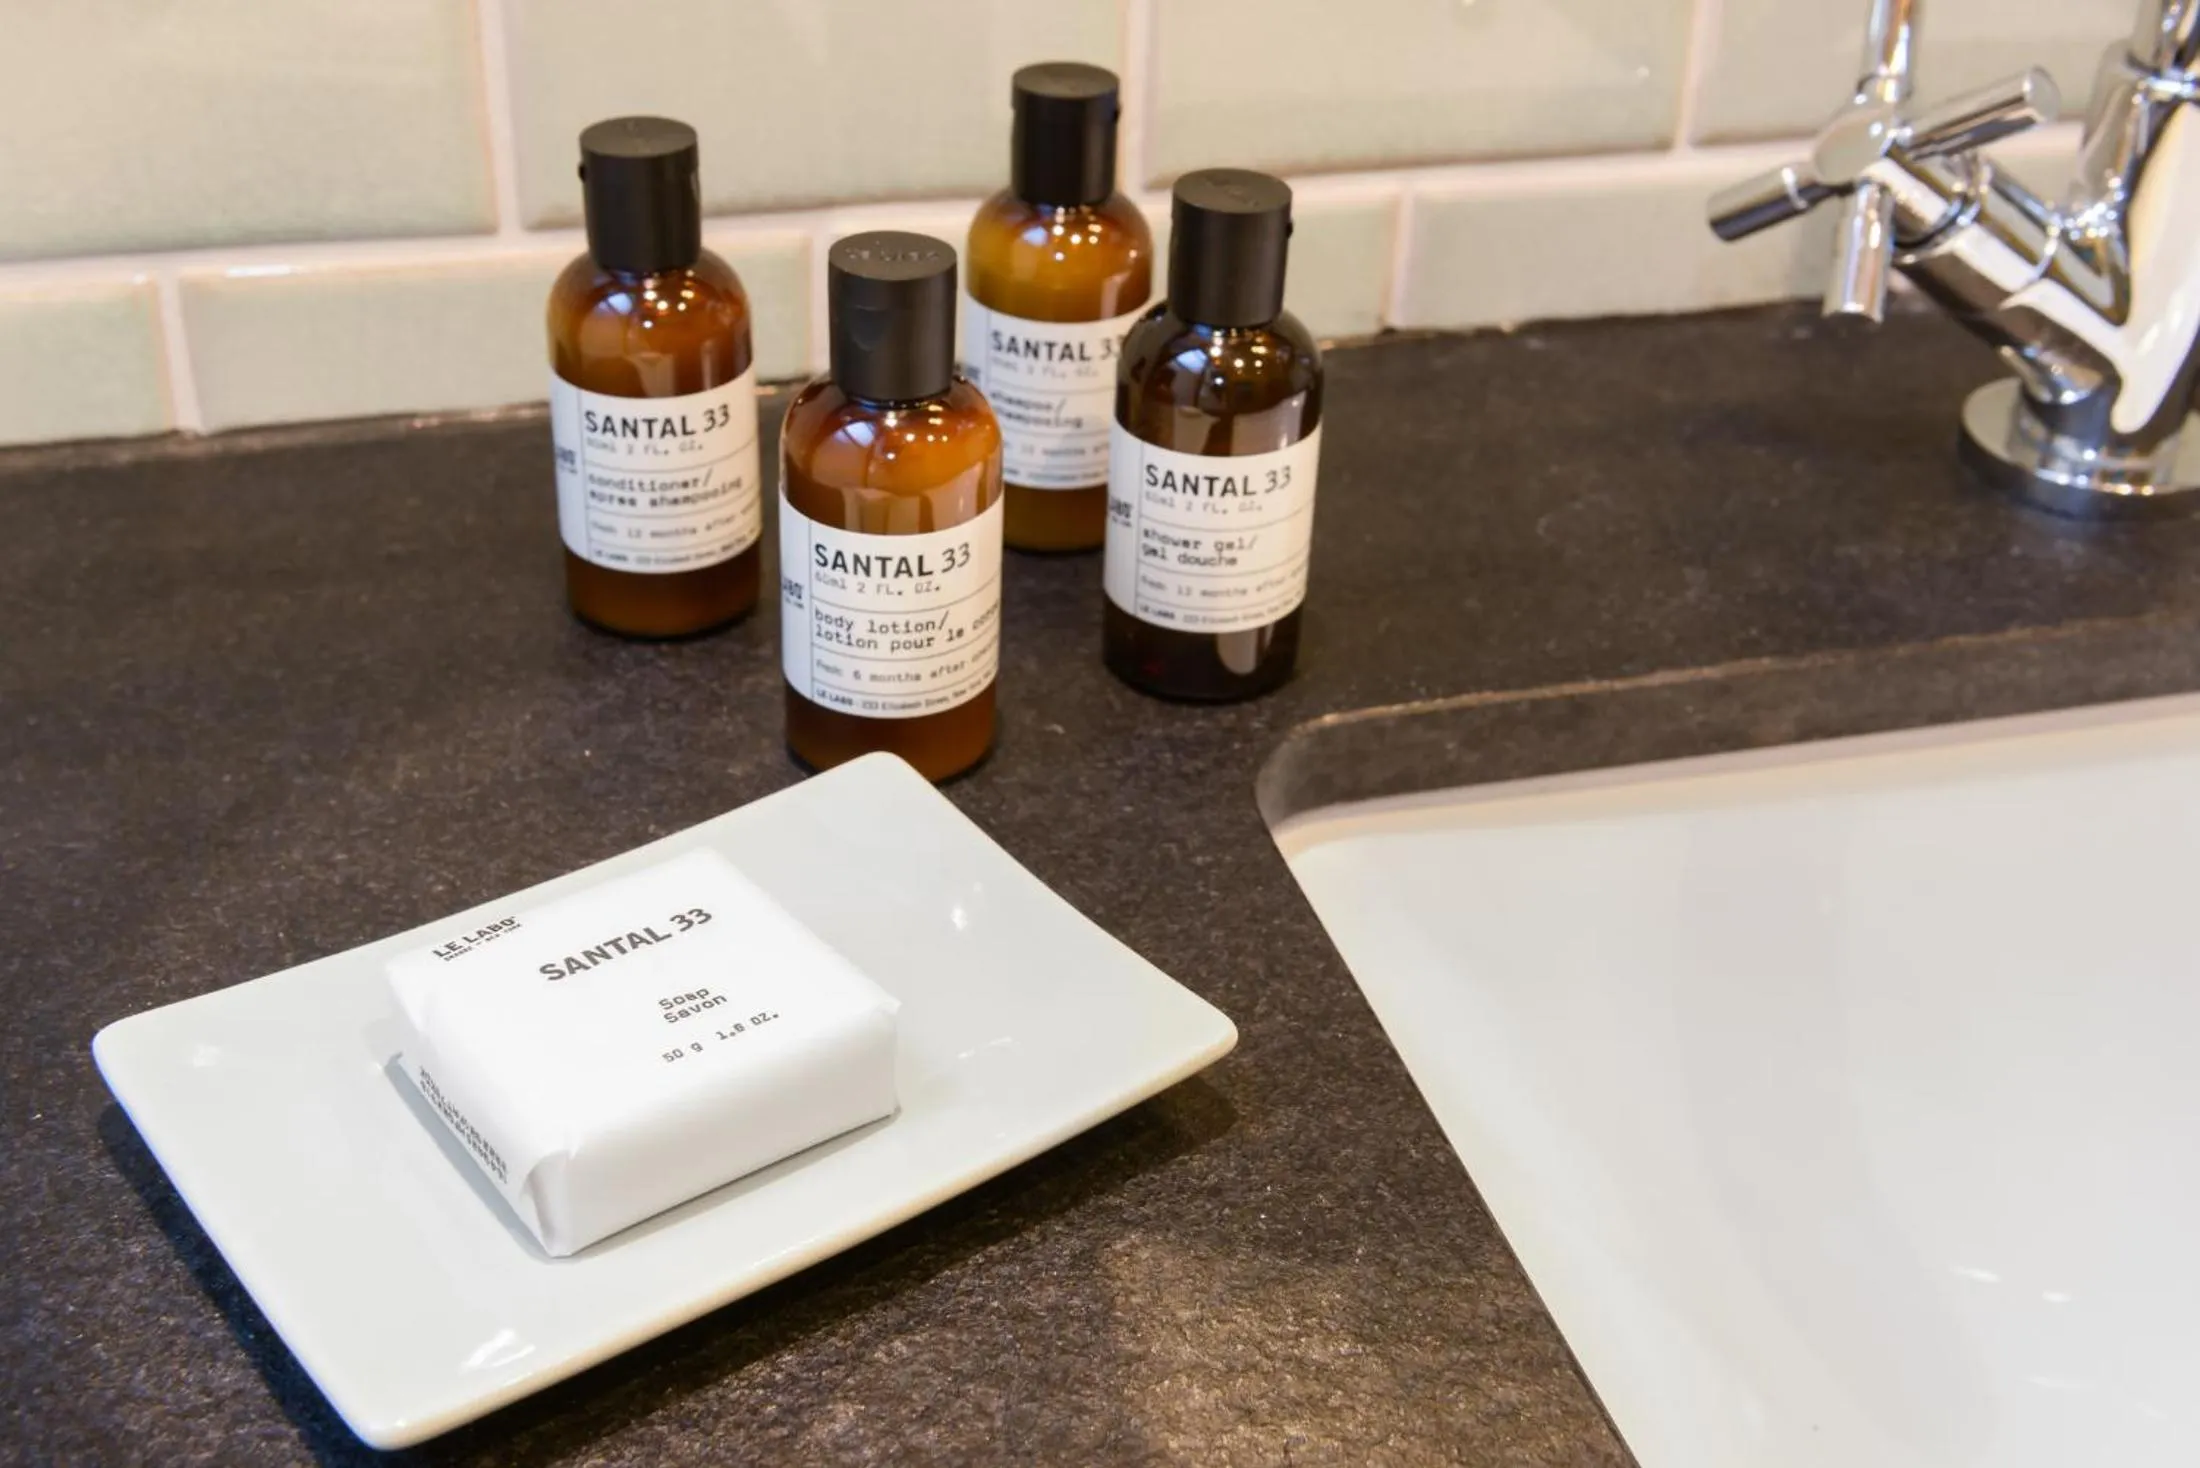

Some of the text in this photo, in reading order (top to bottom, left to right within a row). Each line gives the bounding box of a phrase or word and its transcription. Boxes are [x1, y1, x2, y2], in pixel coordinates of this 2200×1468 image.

[991, 331, 1092, 362] SANTAL
[584, 403, 731, 439] SANTAL 33
[1145, 463, 1257, 498] SANTAL
[1264, 465, 1292, 494] 33
[815, 542, 971, 579] SANTAL 33
[857, 582, 866, 594] 2
[876, 583, 904, 596] FL.
[815, 608, 949, 634] body lotion/
[815, 624, 878, 650] lotion
[890, 637, 935, 653] pour
[946, 628, 965, 642] le
[432, 917, 516, 958] LE LABO
[539, 908, 713, 981] SANTAL 33
[658, 988, 710, 1010] Soap
[663, 995, 728, 1024] Savon
[662, 1048, 685, 1064] 50
